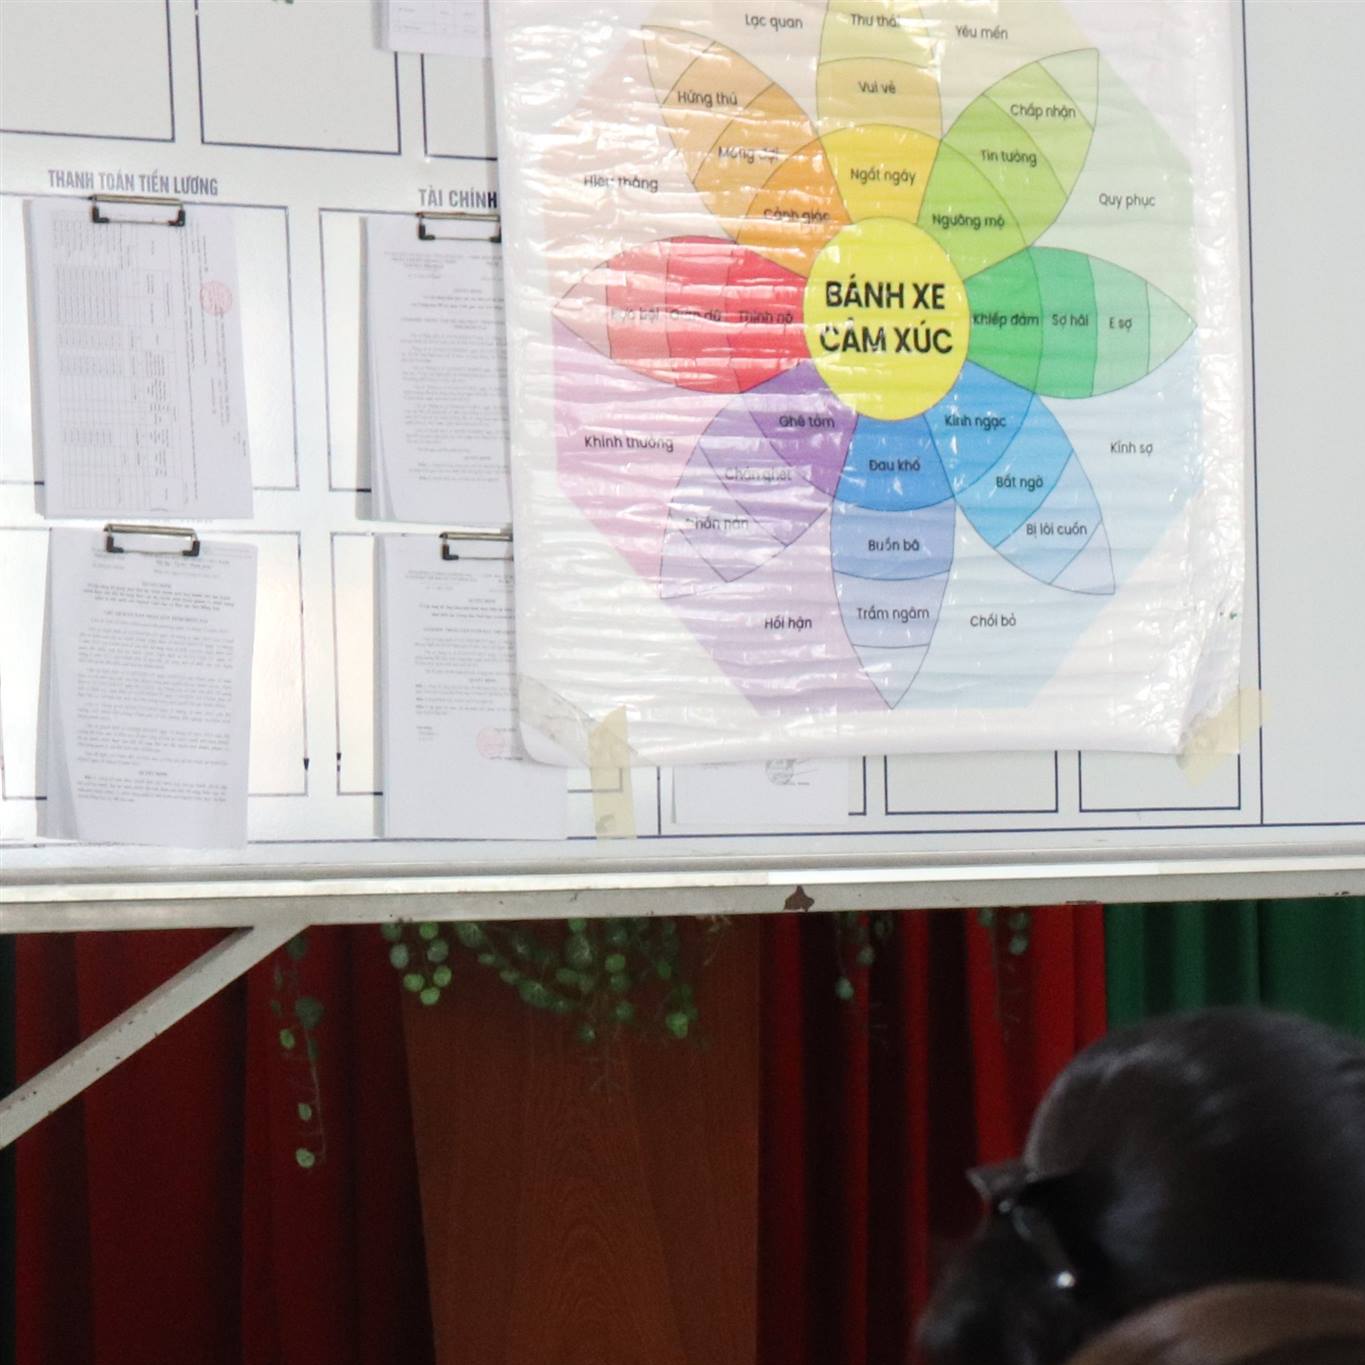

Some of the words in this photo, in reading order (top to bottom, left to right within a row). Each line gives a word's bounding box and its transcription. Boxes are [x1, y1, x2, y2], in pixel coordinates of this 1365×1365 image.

[771, 17, 803, 32] quan
[981, 148, 998, 162] Tin
[48, 169, 94, 190] THANH
[98, 168, 134, 192] TOÁN
[173, 174, 218, 196] LƯƠNG
[418, 184, 443, 207] TÀI
[449, 187, 498, 209] CHÍNH
[1098, 193, 1123, 209] Quy
[1125, 194, 1156, 210] phục
[826, 274, 905, 309] BÁNH
[912, 284, 945, 310] XE
[819, 317, 887, 354] CẢM
[894, 321, 953, 355] XÚC
[584, 436, 624, 449] Khinh
[869, 459, 895, 472] Đau
